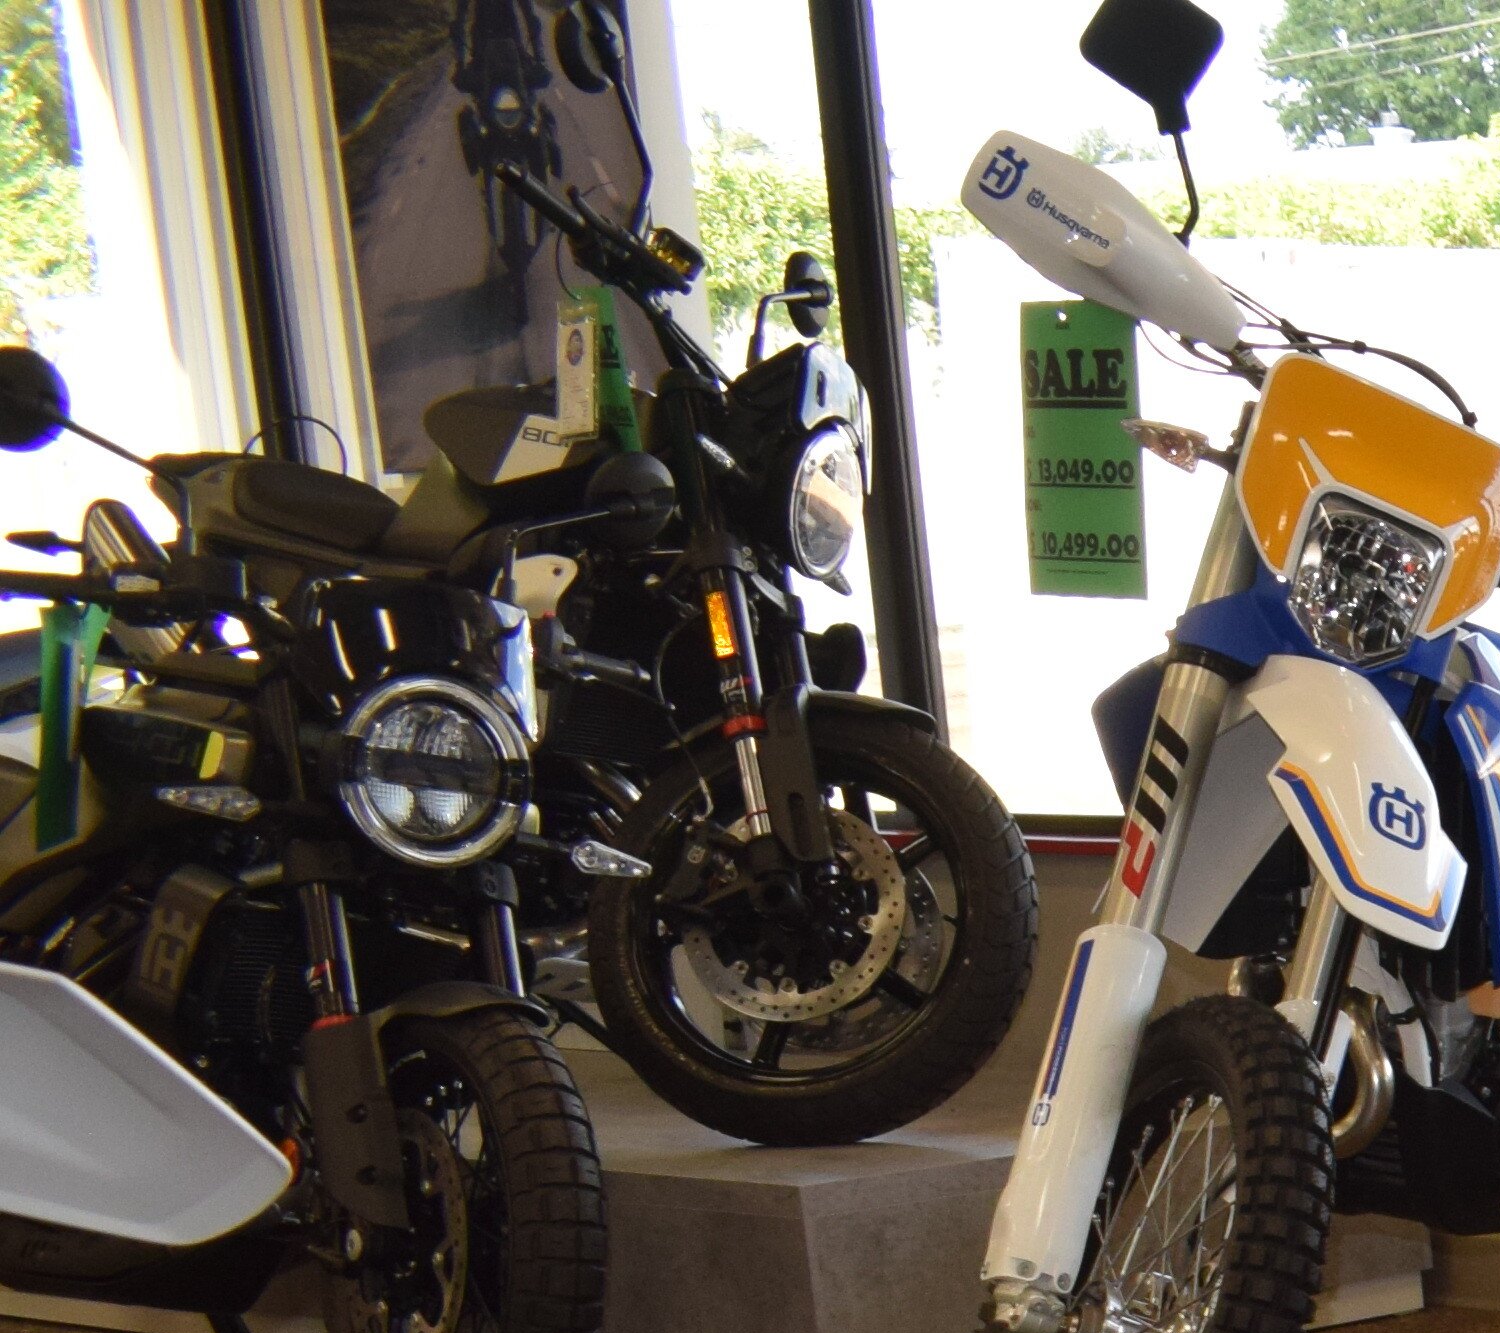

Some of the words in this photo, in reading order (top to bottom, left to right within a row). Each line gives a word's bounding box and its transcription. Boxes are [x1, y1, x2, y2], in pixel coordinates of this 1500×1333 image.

[1043, 201, 1110, 250] Husqvarna
[1025, 348, 1127, 399] SALE
[1038, 458, 1135, 485] 13,049.00
[1042, 530, 1140, 560] 10,499.00
